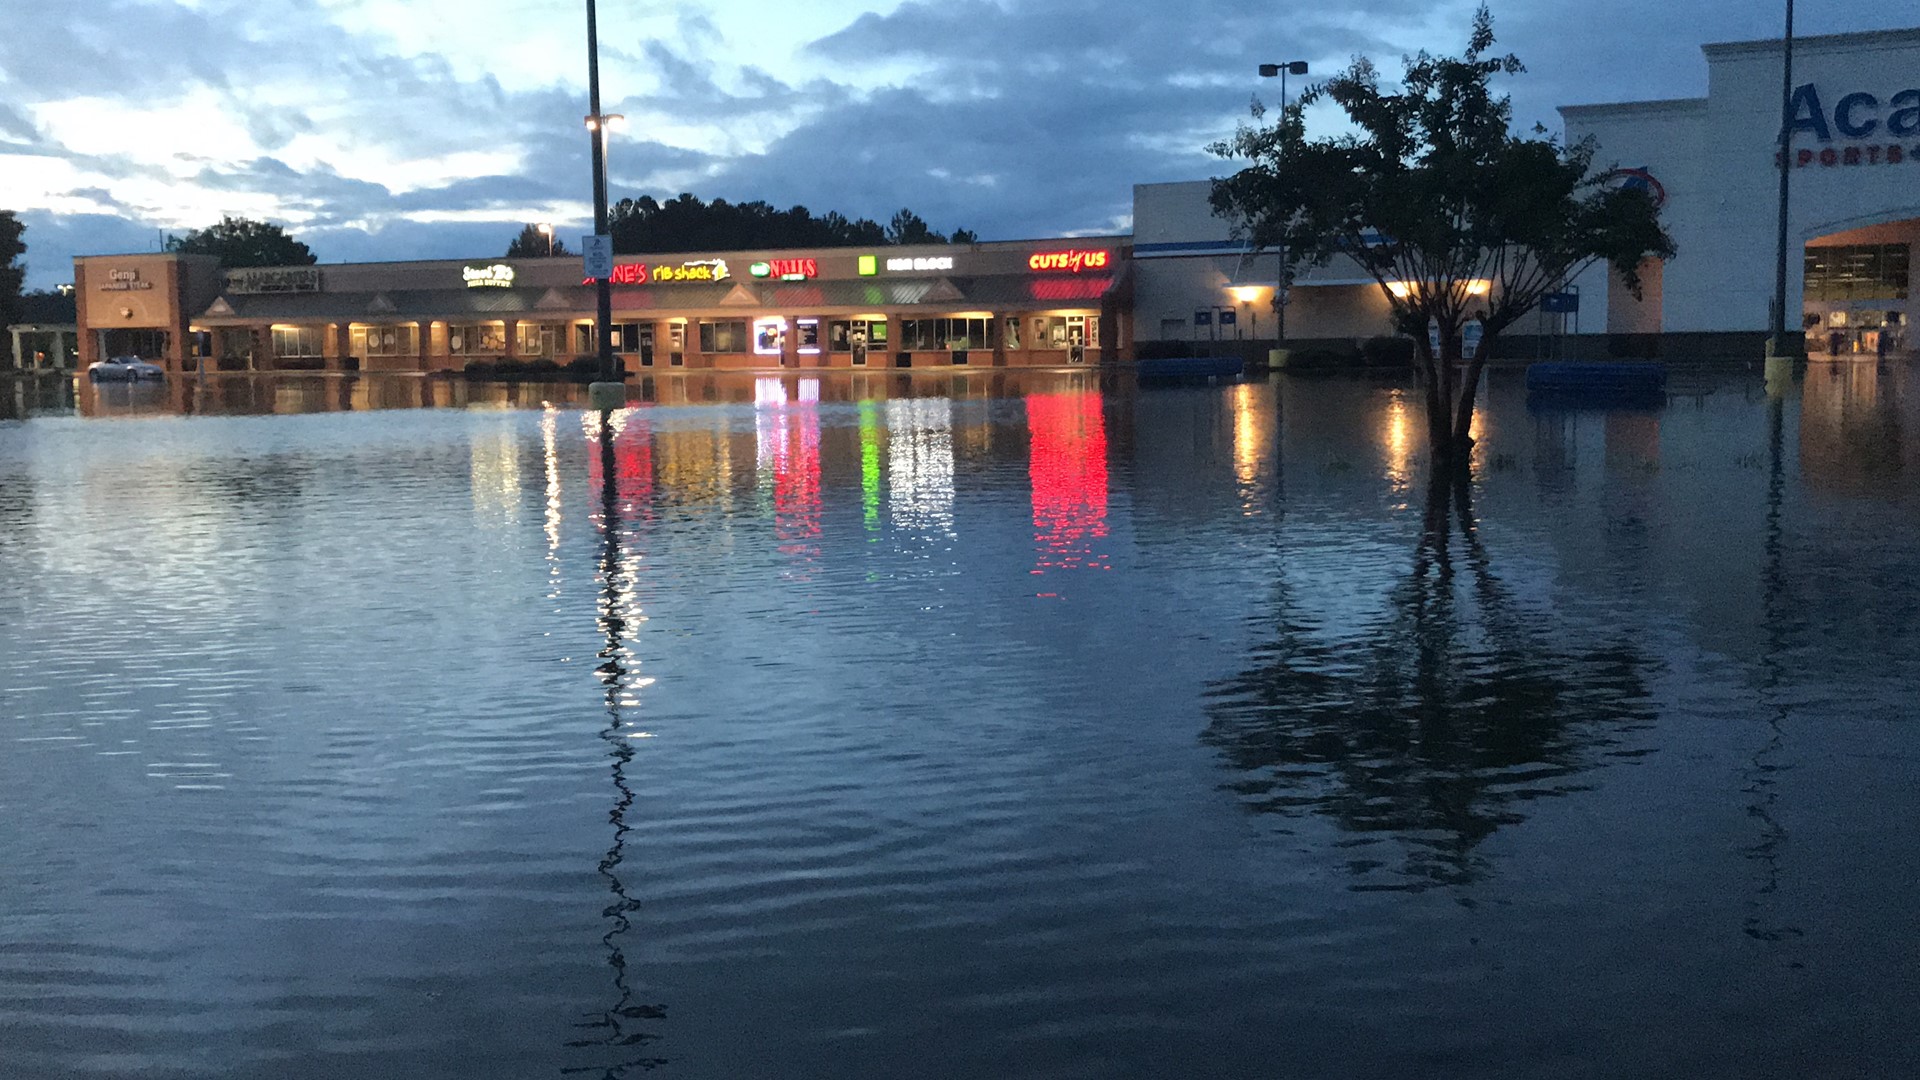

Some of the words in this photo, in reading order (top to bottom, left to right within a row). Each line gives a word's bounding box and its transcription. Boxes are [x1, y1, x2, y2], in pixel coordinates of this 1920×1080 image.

[770, 258, 817, 278] NAILS
[913, 257, 952, 270] BLOCK
[1029, 253, 1068, 269] CUTS
[1068, 249, 1085, 272] by
[1084, 252, 1106, 267] US
[675, 264, 711, 281] shack
